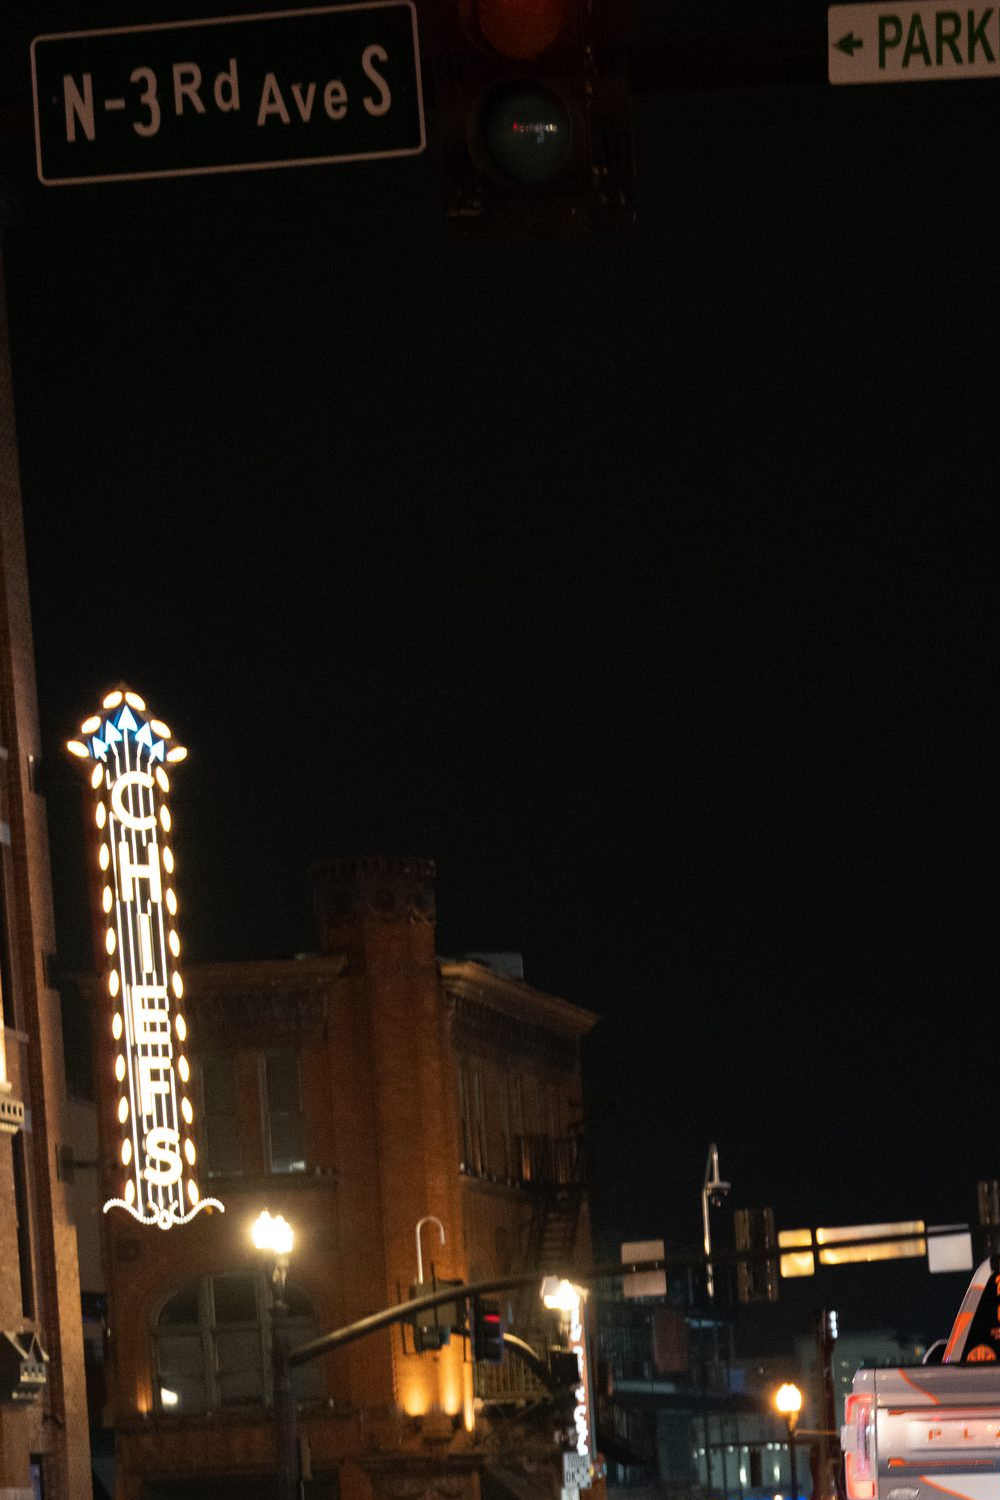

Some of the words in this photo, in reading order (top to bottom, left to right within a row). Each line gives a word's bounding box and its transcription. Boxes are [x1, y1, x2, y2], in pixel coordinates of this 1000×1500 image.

[257, 73, 349, 127] Ave
[361, 44, 393, 117] S
[110, 770, 184, 1185] CHIEFS
